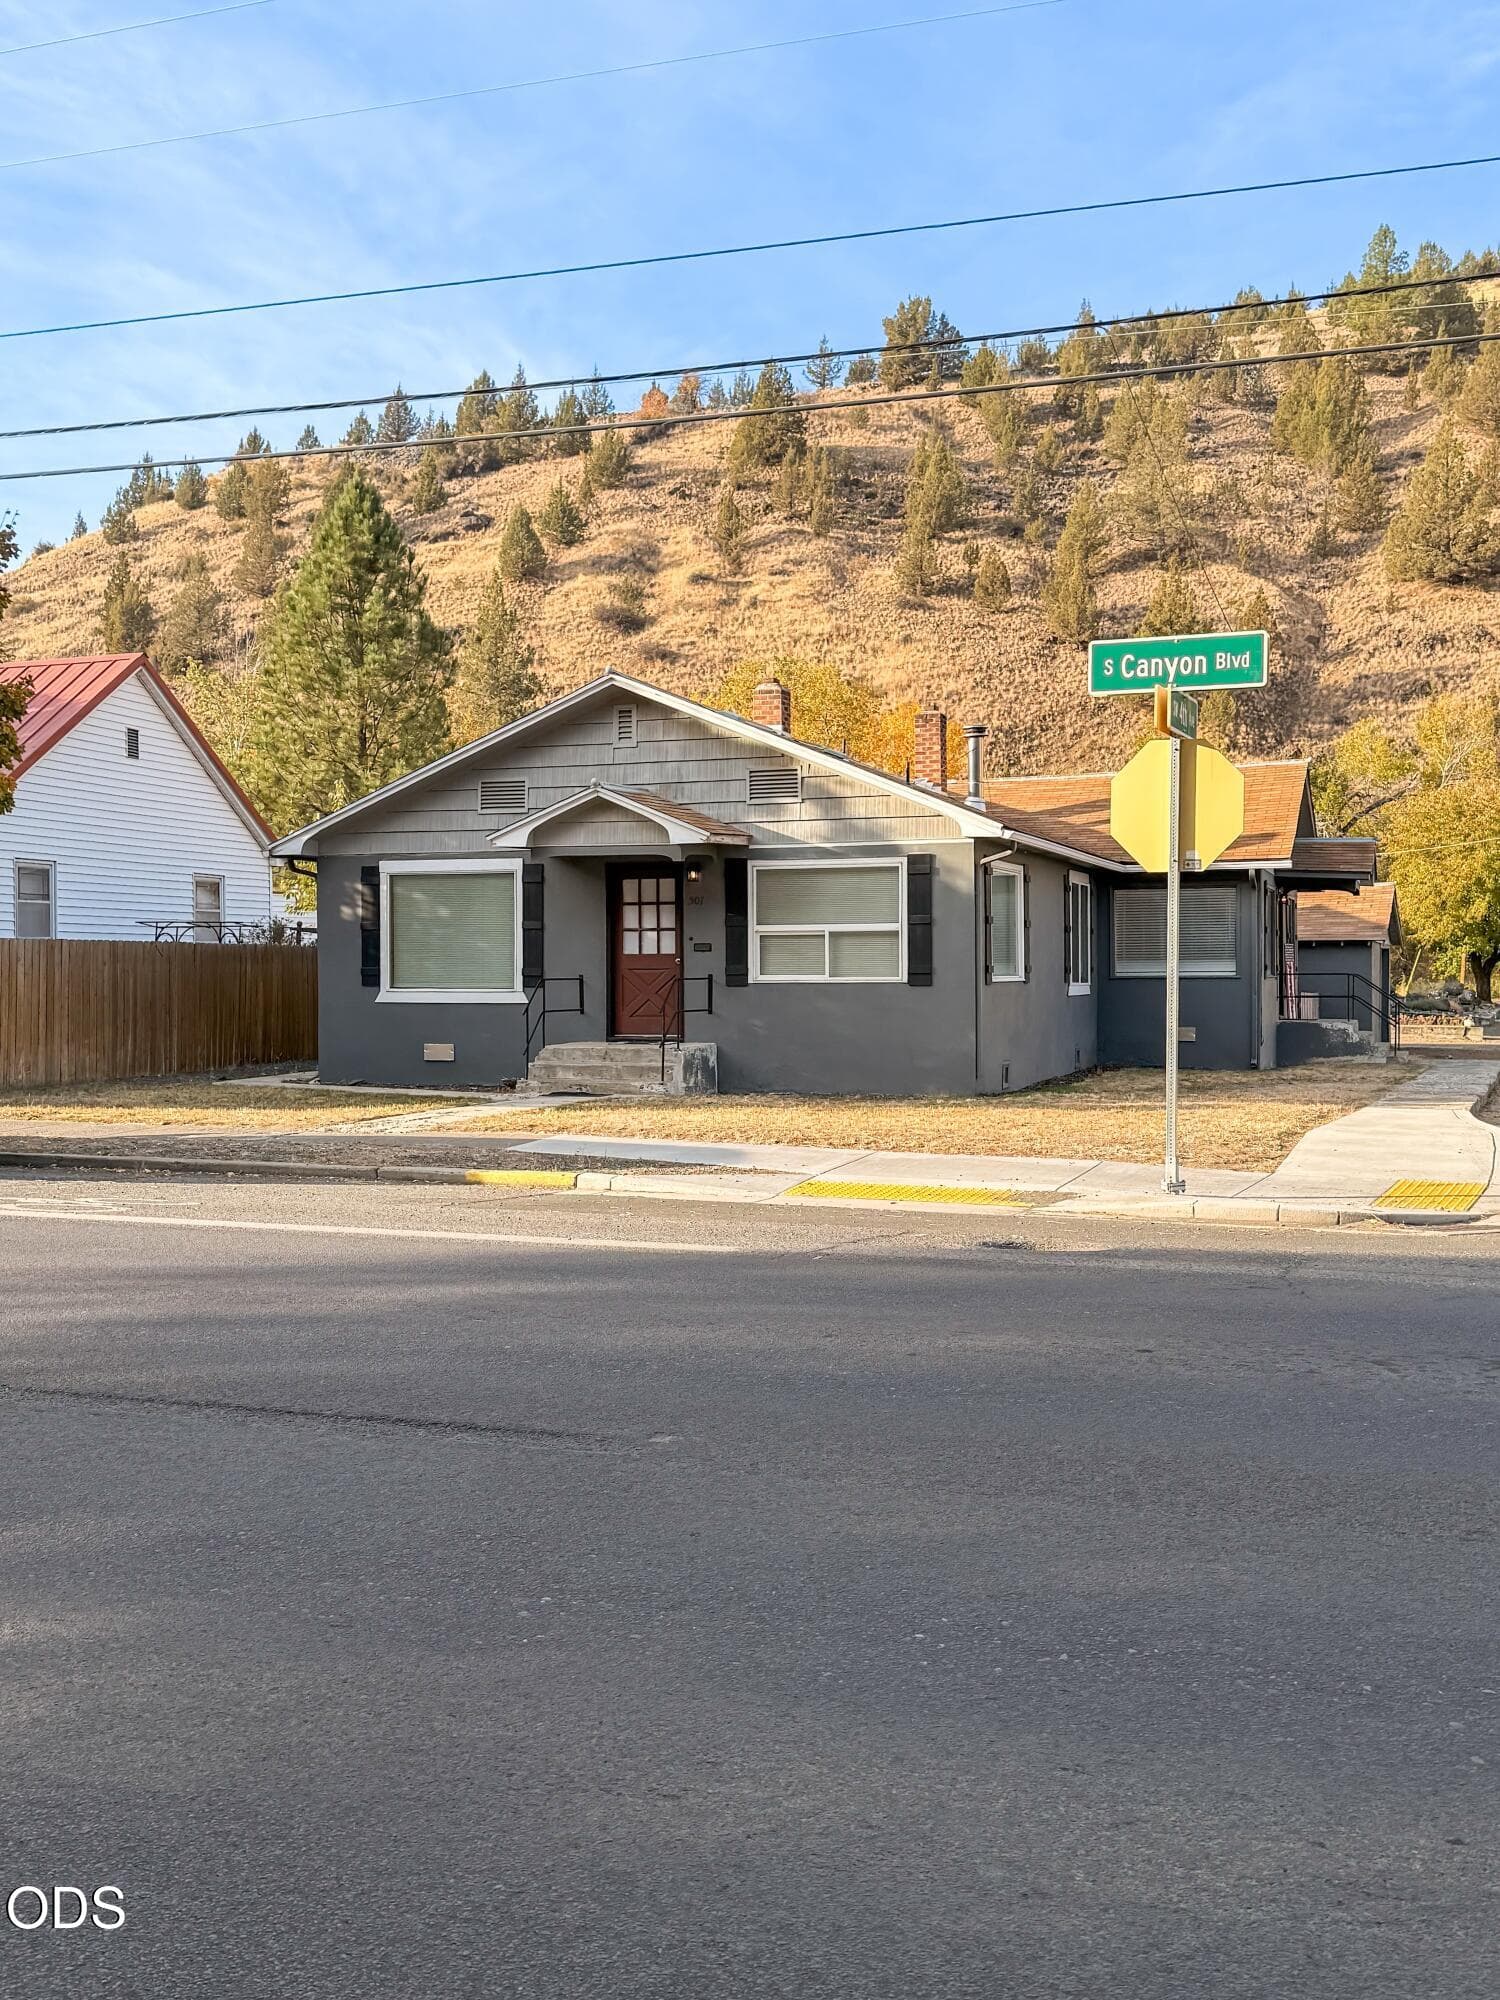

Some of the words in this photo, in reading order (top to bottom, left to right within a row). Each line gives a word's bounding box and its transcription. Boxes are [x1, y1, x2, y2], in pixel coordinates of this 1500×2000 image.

[1103, 658, 1114, 676] S
[1121, 654, 1207, 683] Canyon
[1215, 651, 1250, 670] Blvd
